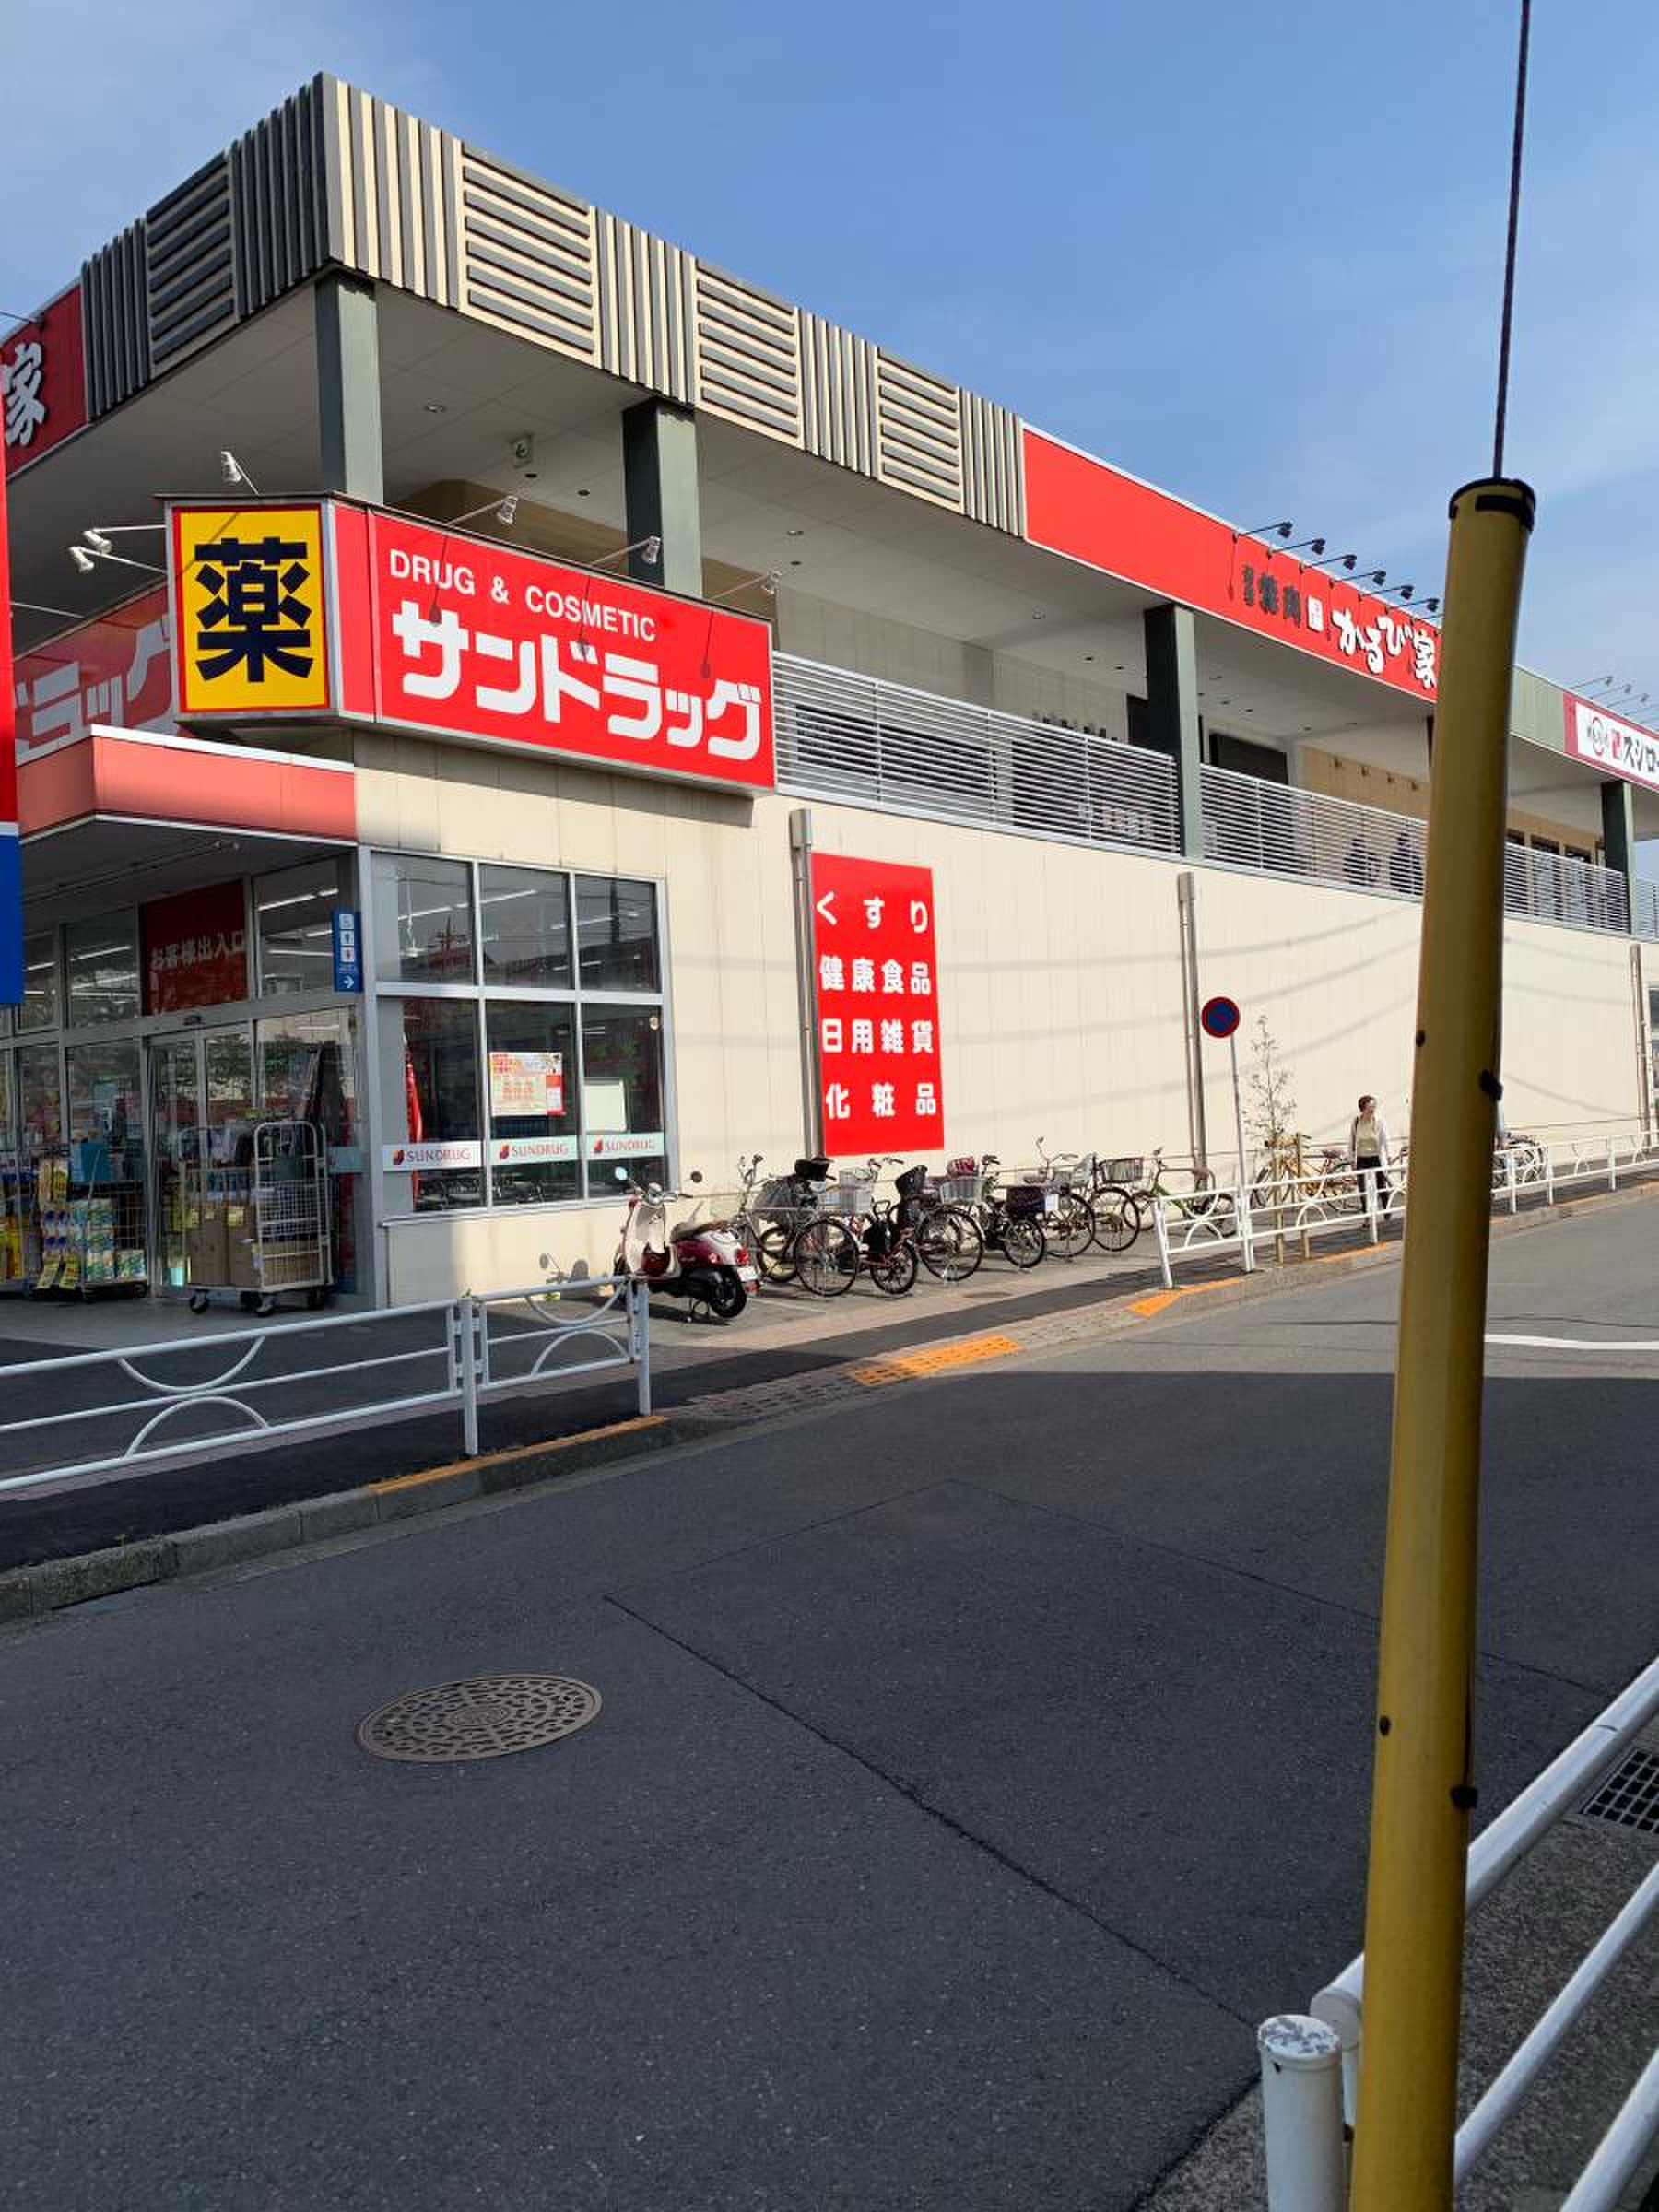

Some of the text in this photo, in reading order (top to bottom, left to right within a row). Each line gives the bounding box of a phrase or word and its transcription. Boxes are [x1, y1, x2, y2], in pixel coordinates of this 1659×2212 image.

[194, 537, 314, 683] 薬
[390, 549, 657, 642] DRUG & COSMETIC
[392, 600, 762, 760] サンドラッグ
[816, 890, 929, 934] くすり
[819, 954, 932, 995] 健康食品
[821, 1018, 934, 1054] 日用雑貨
[826, 1082, 937, 1120] 化粧品
[406, 1148, 472, 1163] SUNDRUG
[512, 1142, 568, 1157] SUNDRUG
